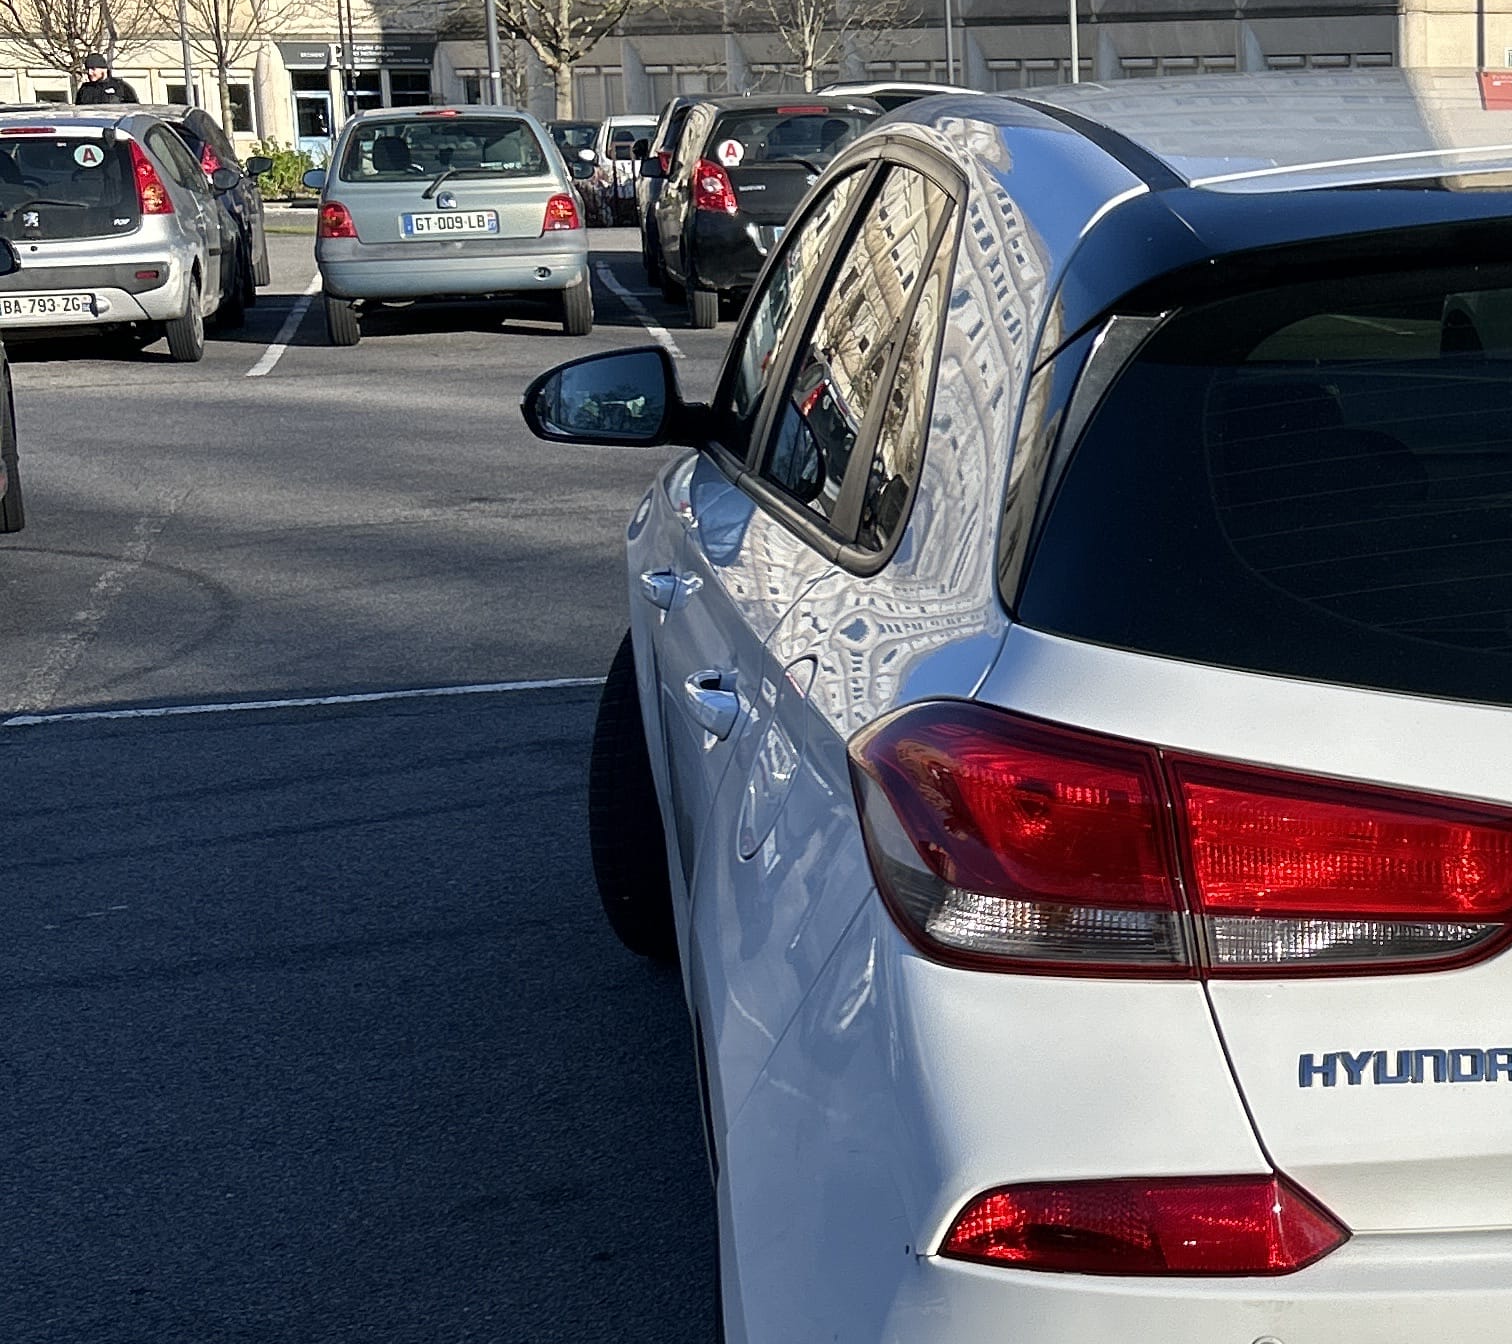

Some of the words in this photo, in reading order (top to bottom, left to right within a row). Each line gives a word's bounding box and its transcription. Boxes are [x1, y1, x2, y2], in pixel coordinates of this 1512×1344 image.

[82, 147, 98, 163] A
[725, 143, 738, 158] A
[3, 297, 81, 314] BA-793-ZG
